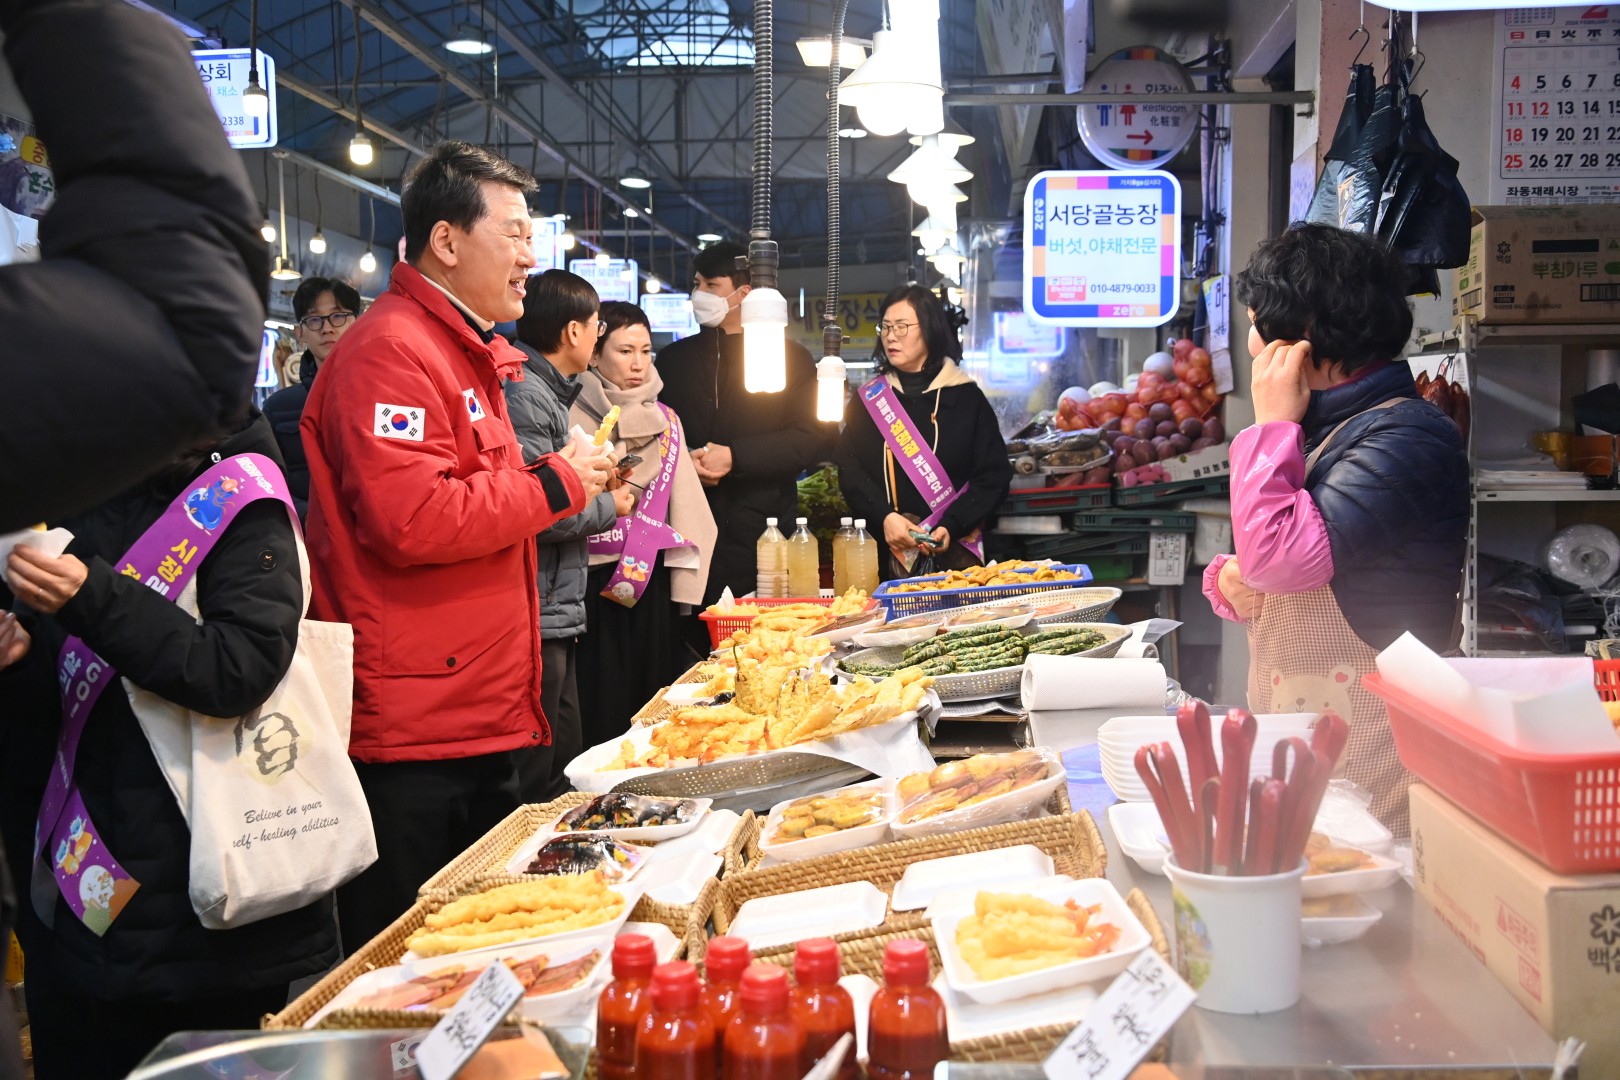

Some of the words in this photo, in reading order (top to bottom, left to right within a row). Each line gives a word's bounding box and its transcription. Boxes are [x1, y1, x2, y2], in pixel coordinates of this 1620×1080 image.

[1510, 31, 1525, 40] 日
[1536, 30, 1551, 39] 月
[1562, 30, 1576, 39] 火
[1511, 75, 1520, 90] 4
[1536, 74, 1546, 89] 5
[1562, 74, 1572, 88] 6
[1587, 74, 1598, 88] 7
[216, 86, 238, 97] 채소
[1508, 102, 1523, 116] 11
[1532, 102, 1550, 116] 12
[1557, 101, 1574, 114] 13
[1583, 101, 1600, 114] 14
[222, 116, 244, 126] 2338
[1506, 128, 1523, 142] 18
[1532, 128, 1549, 142] 19
[1556, 127, 1575, 142] 20
[1582, 127, 1600, 141] 21
[1504, 154, 1523, 169] 25
[1529, 154, 1548, 168] 26
[1554, 154, 1574, 168] 27
[1580, 154, 1599, 168] 28
[1506, 186, 1578, 196] 좌동재래시장
[1049, 204, 1158, 226] 서당골농장
[1049, 238, 1158, 255] 버섯,야채전문
[1532, 261, 1598, 280] 부침가루
[1090, 284, 1156, 293] 010-4879-0033
[912, 454, 943, 494] 보내세요
[244, 809, 282, 824] Believe
[286, 806, 298, 815] in
[302, 800, 322, 814] your
[232, 826, 298, 850] self-healing
[302, 816, 340, 833] abilities
